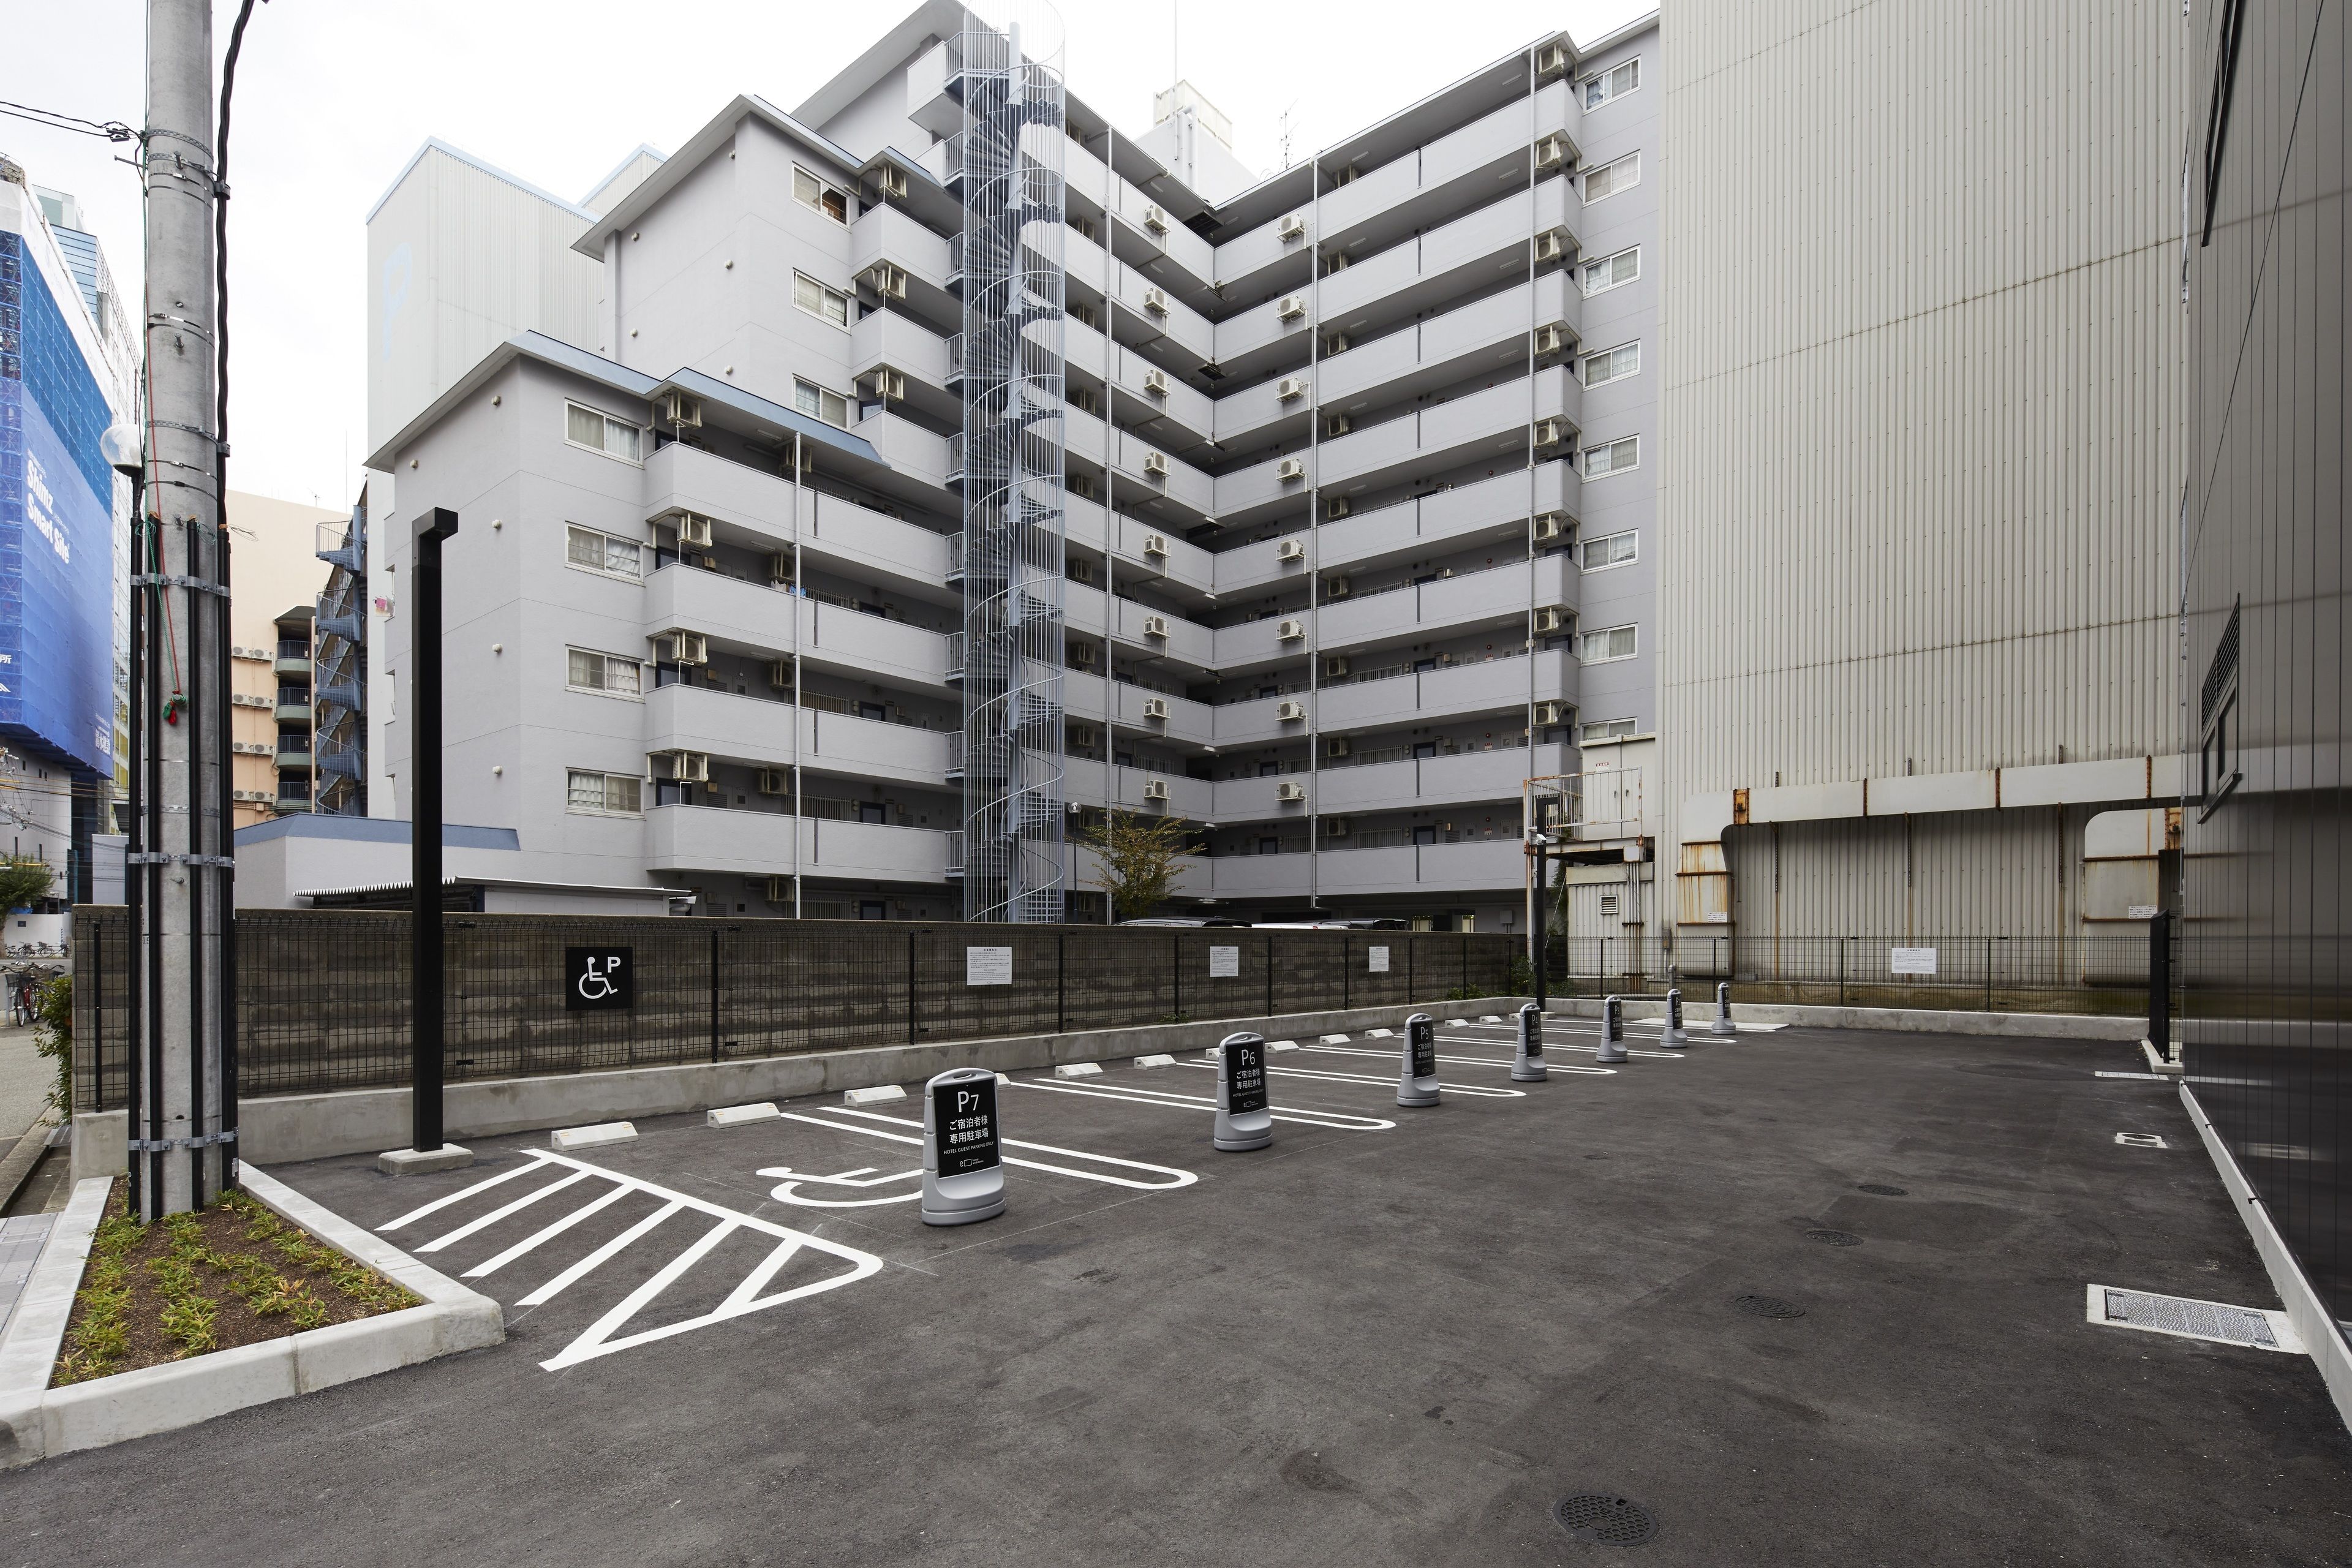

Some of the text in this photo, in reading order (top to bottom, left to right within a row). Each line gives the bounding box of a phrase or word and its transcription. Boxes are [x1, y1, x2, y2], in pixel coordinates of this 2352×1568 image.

[383, 242, 412, 363] P
[28, 459, 53, 514] Shimz
[28, 492, 53, 544] Smart
[54, 527, 69, 564] Site
[608, 956, 620, 973] P
[1420, 1027, 1429, 1039] P5
[1242, 1049, 1256, 1066] P6
[1237, 1068, 1260, 1079] ご宿泊者様
[1237, 1078, 1261, 1089] 専用駐車場
[957, 1091, 979, 1113] P7
[949, 1115, 988, 1130] ご宿泊者様
[949, 1128, 989, 1144] 専用駐車場
